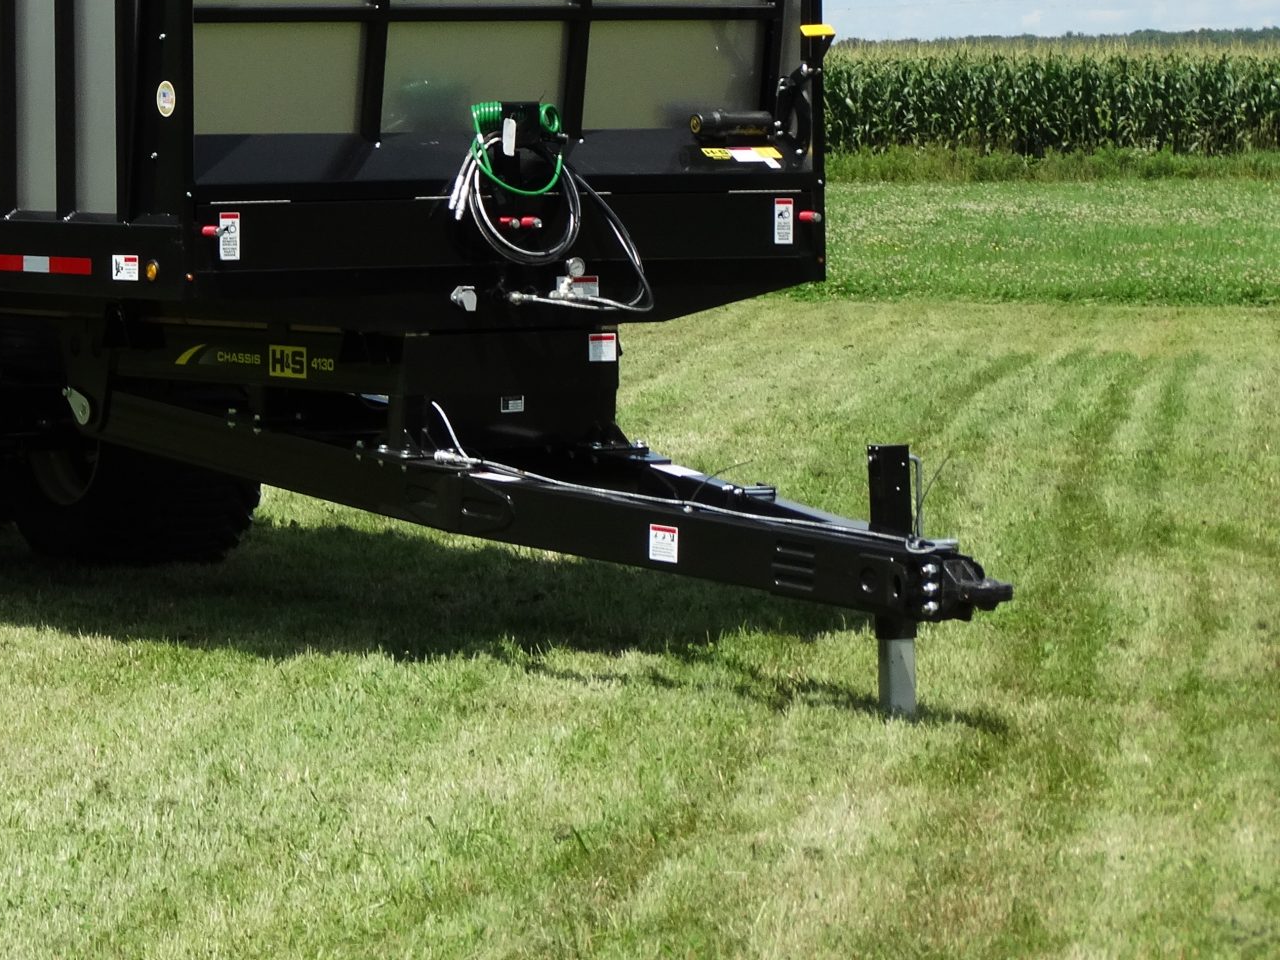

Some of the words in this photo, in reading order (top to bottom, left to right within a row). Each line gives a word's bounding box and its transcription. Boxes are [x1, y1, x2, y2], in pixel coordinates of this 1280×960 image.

[217, 351, 261, 365] CHASSIS
[271, 349, 305, 375] H&S
[311, 357, 335, 371] 4130
